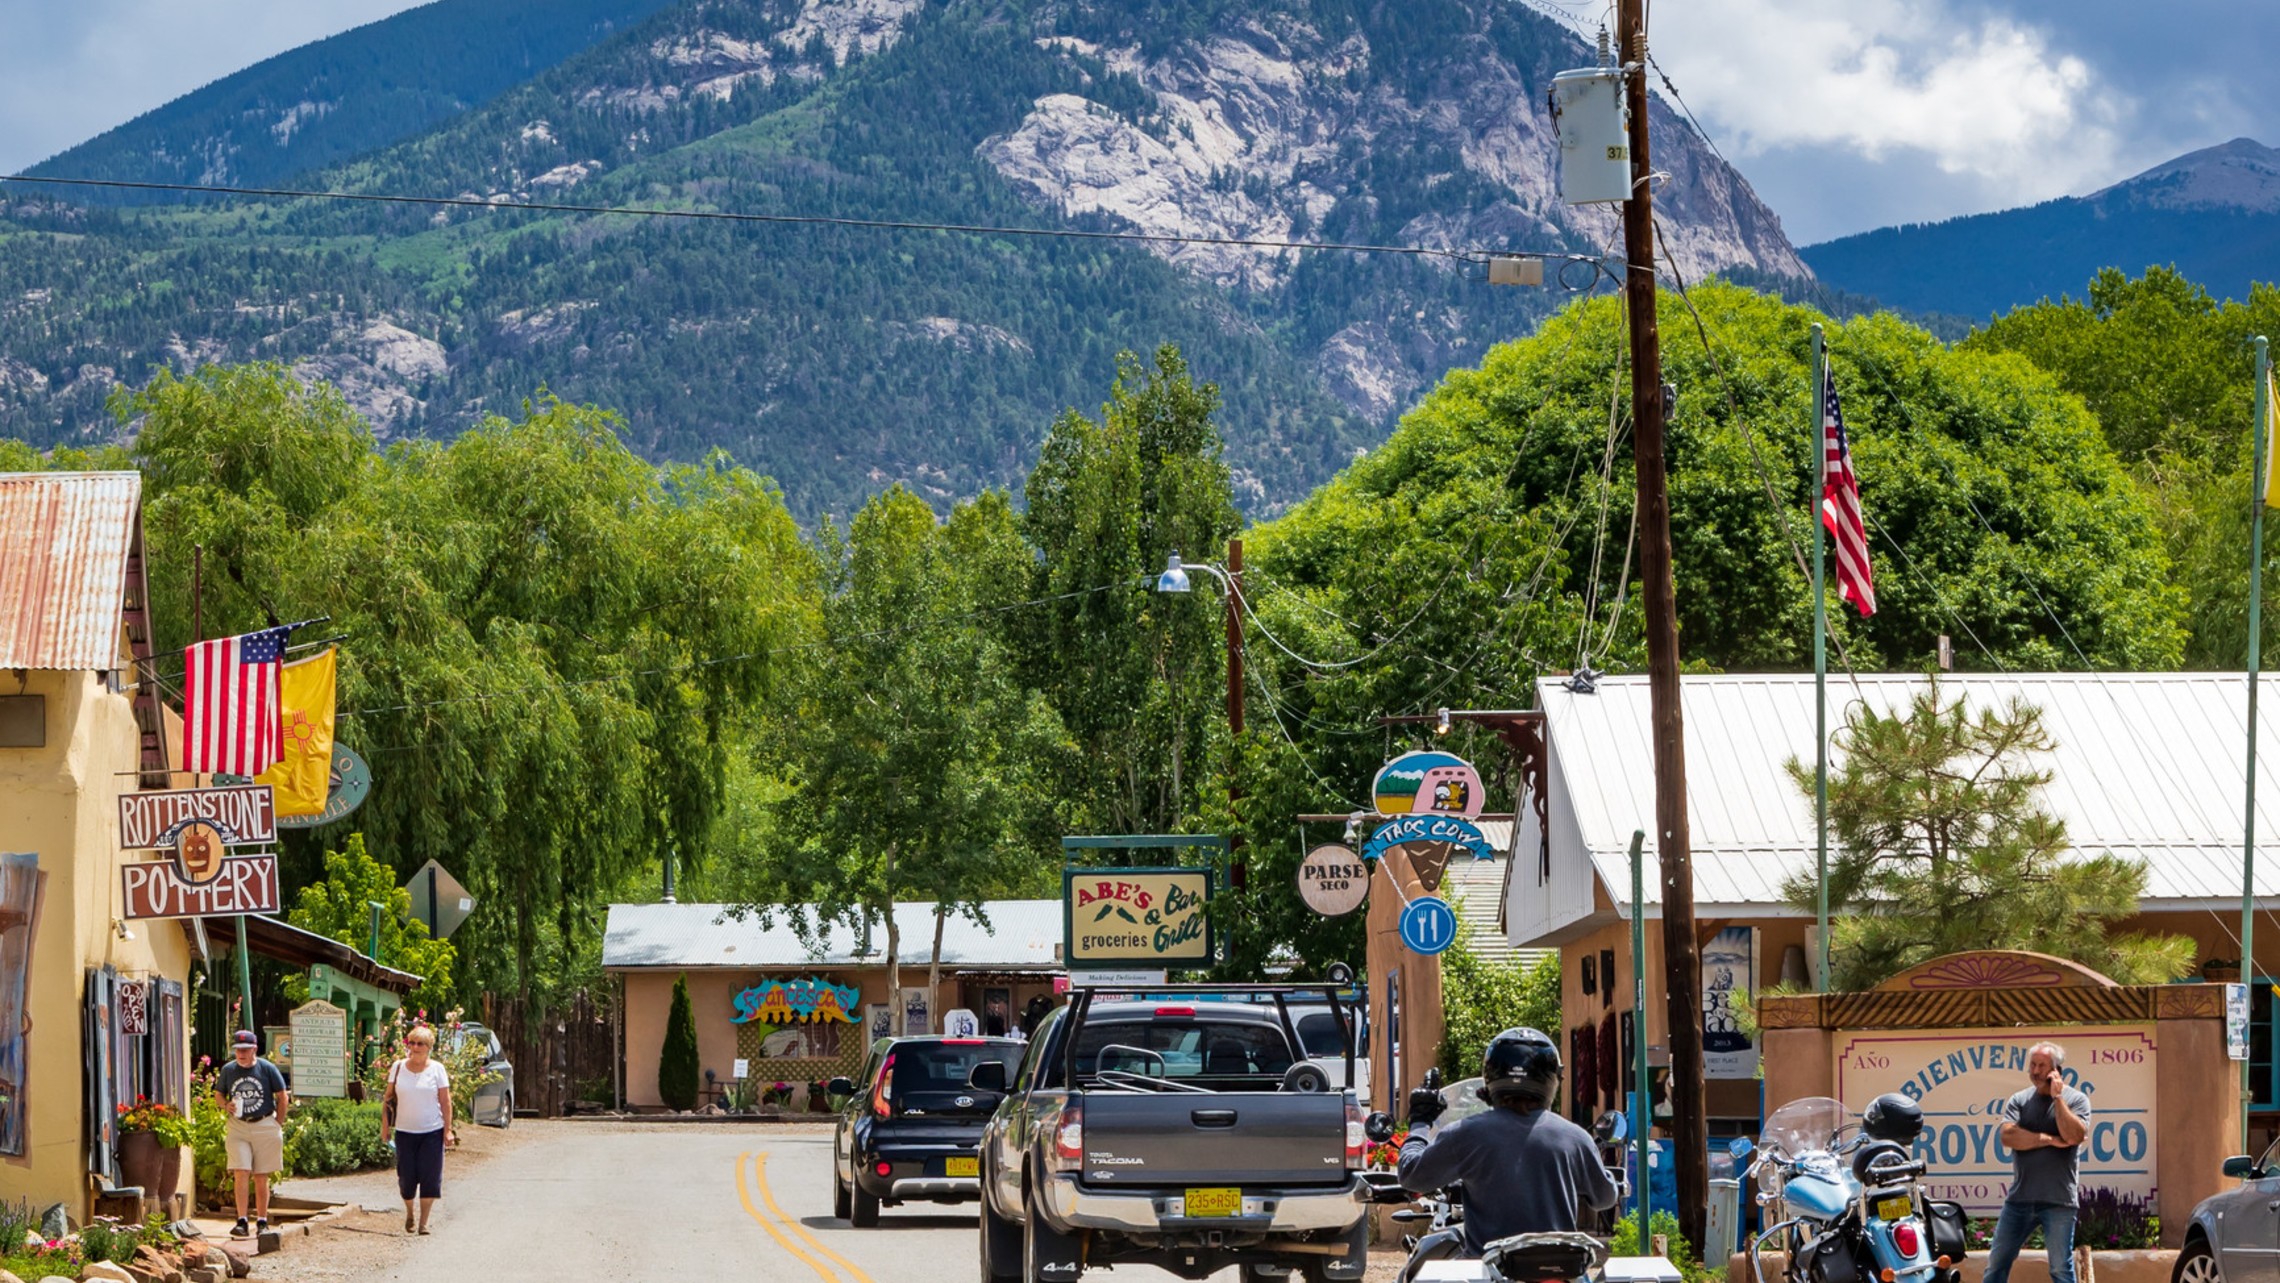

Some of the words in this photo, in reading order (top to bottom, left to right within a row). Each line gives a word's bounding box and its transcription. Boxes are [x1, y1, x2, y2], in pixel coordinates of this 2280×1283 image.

[121, 789, 272, 847] ROTTENSTONE
[1375, 818, 1427, 843] TAOS
[1430, 820, 1482, 843] COW
[1304, 864, 1364, 880] PARSE
[124, 859, 272, 916] POTTERY
[1077, 881, 1153, 910] ABE'S
[1320, 881, 1349, 891] SECO
[1164, 883, 1198, 916] Bar
[1143, 908, 1162, 926] &
[1081, 931, 1147, 950] groceries
[1153, 912, 1204, 953] Grill
[1088, 974, 1114, 982] Making
[121, 984, 144, 1033] OPEN
[1853, 1052, 1890, 1070] AÑO
[2091, 1049, 2144, 1065] 1806
